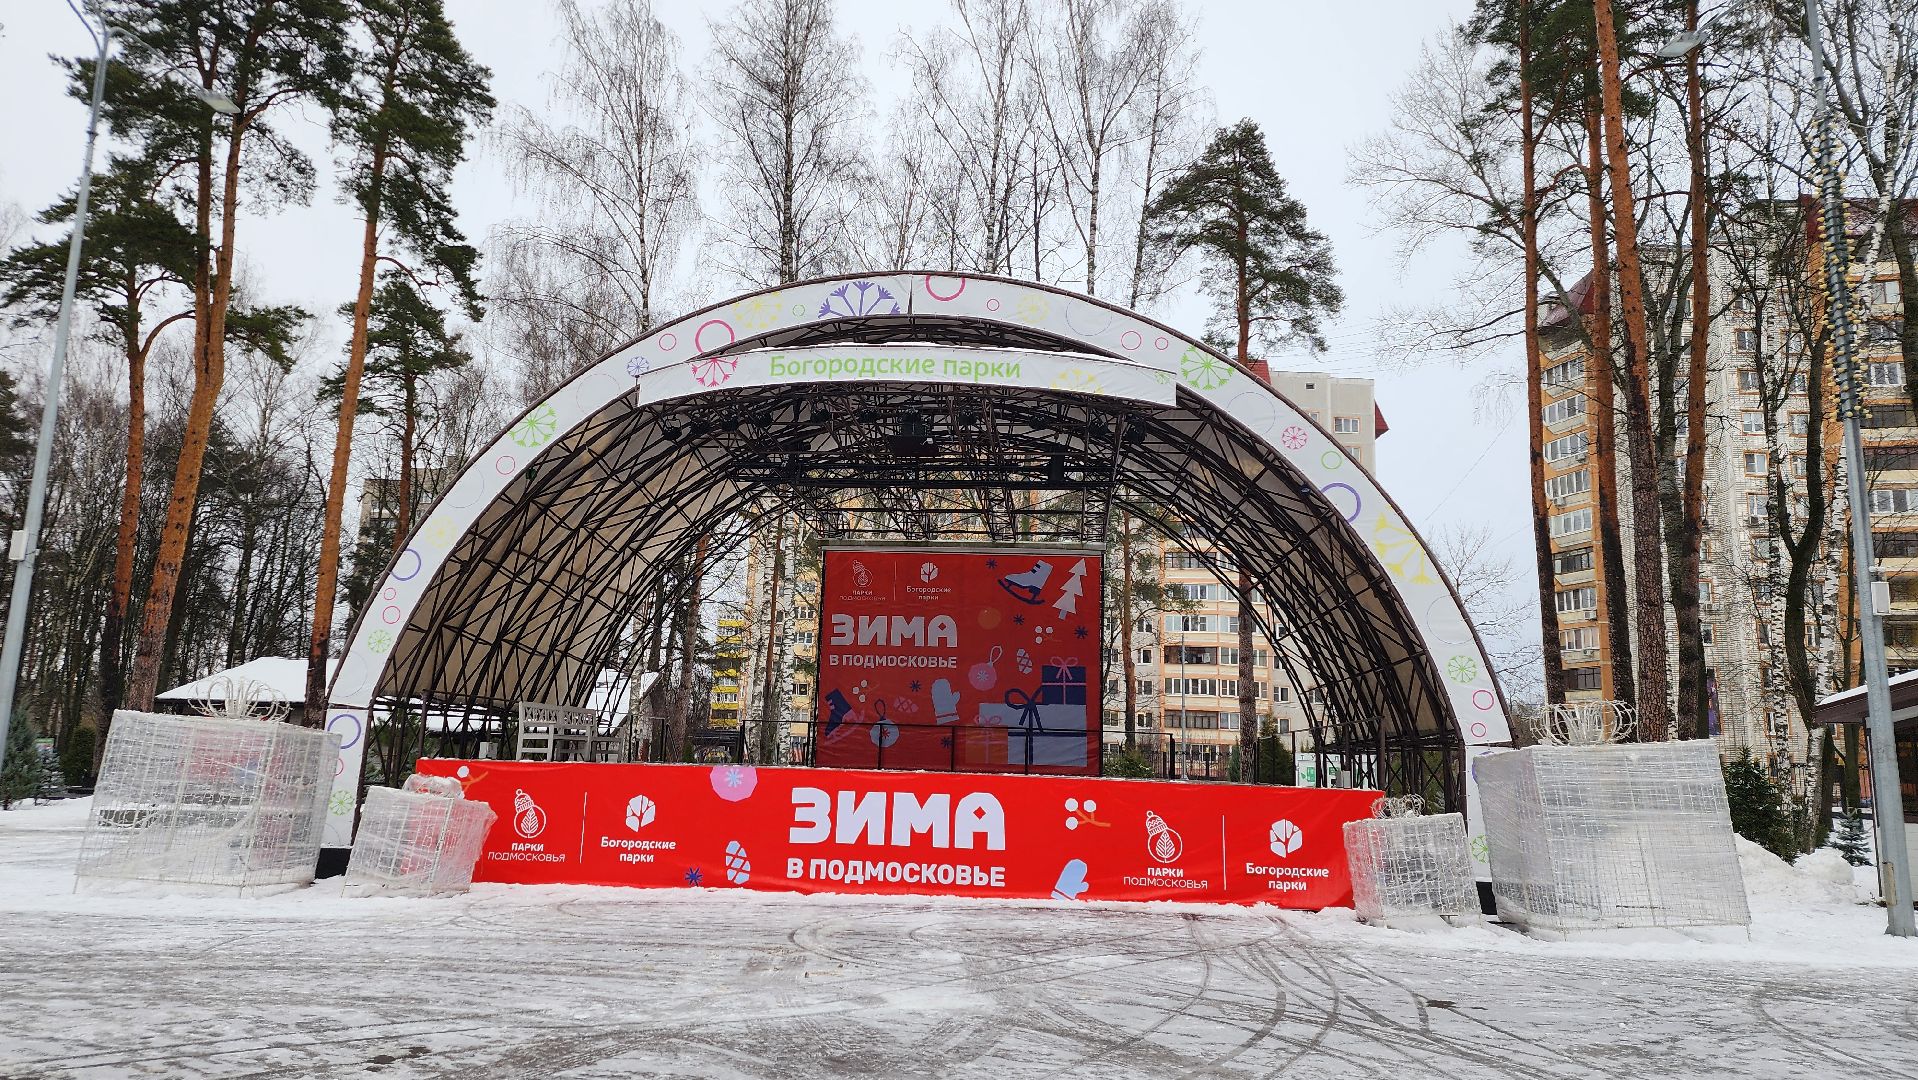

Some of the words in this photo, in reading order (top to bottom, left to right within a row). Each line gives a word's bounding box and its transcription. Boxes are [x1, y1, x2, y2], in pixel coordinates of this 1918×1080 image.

[769, 356, 936, 380] Богородские
[943, 358, 1021, 383] парки
[830, 614, 958, 648] ЗИМА
[829, 655, 840, 666] В
[842, 655, 957, 669] ПОДМОСКОВЬЕ
[789, 787, 1006, 850] ЗИМА
[511, 842, 544, 852] ПАРКИ
[600, 836, 677, 850] Богородские
[487, 851, 566, 863] ПОДМОСКОВЬЯ
[619, 853, 655, 865] парки
[786, 858, 803, 879] В
[809, 858, 1006, 887] ПОДМОСКОВЬЕ
[1147, 867, 1184, 878] ПАРКИ
[1245, 862, 1330, 879] Богородские
[1123, 876, 1208, 890] ПОДМОСКОВЬЯ
[1268, 880, 1307, 893] парки
